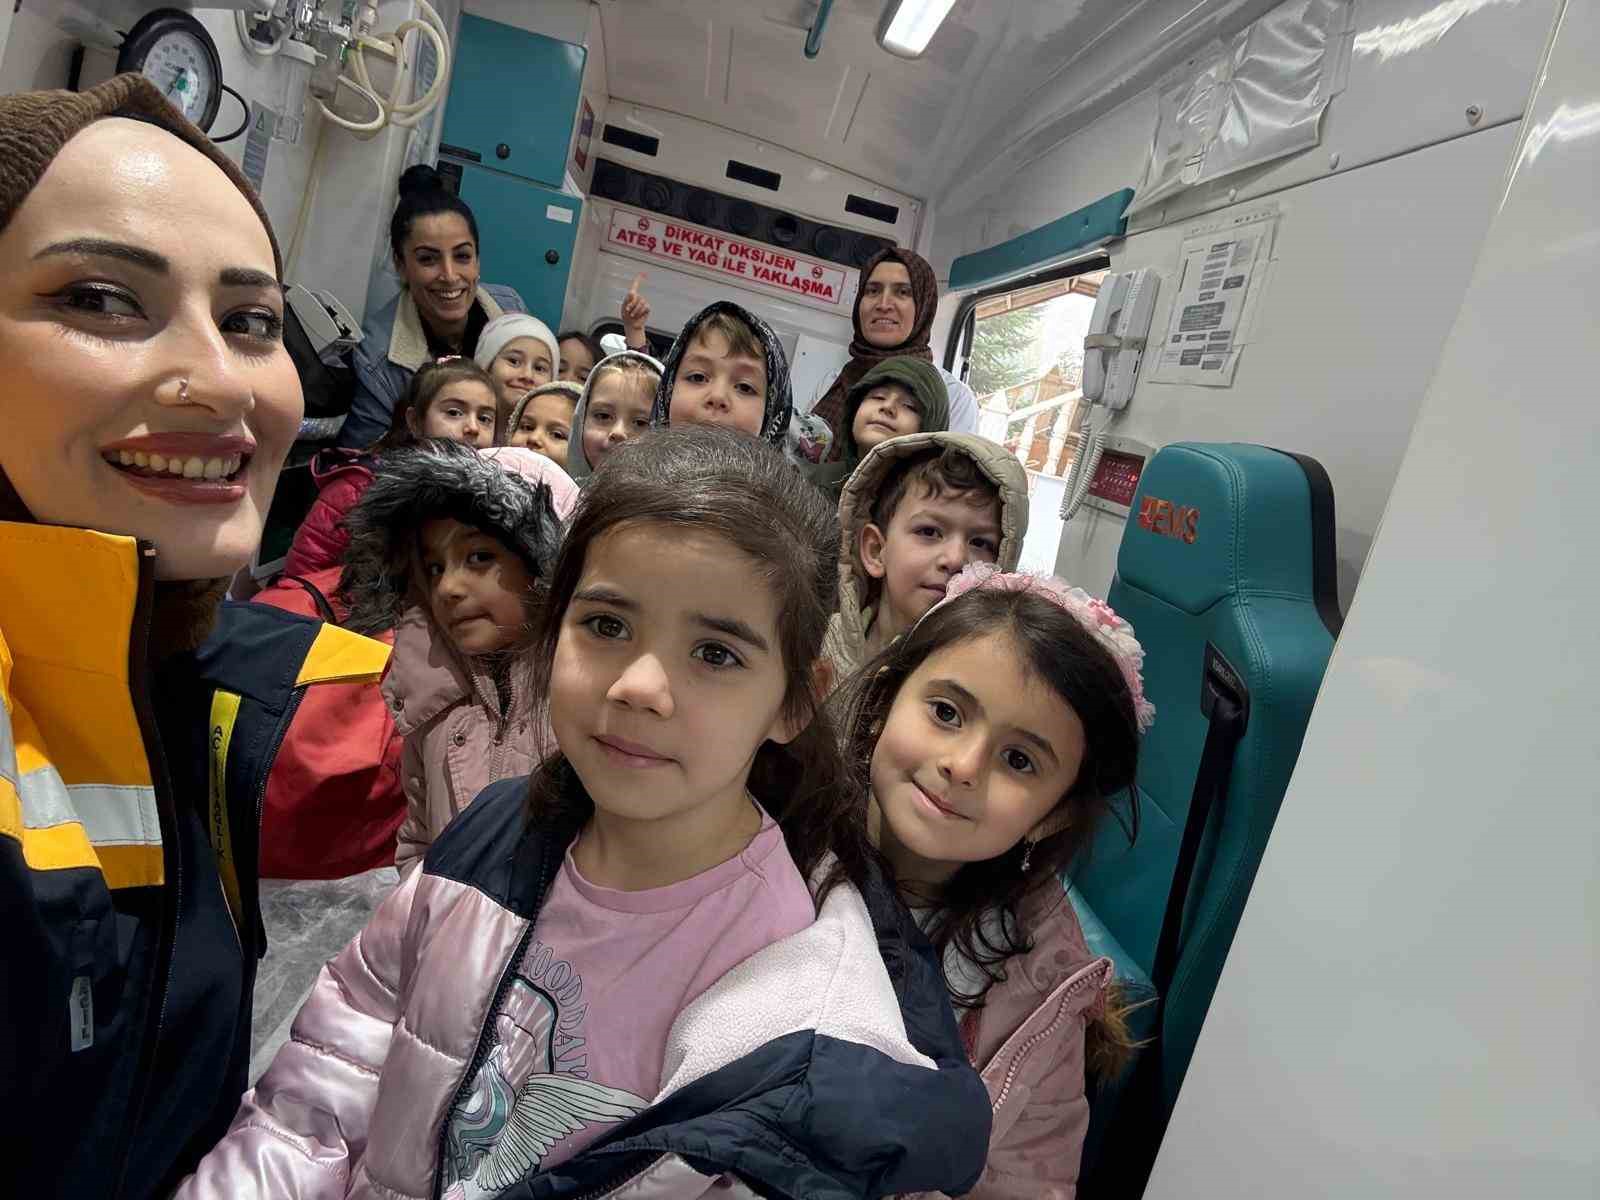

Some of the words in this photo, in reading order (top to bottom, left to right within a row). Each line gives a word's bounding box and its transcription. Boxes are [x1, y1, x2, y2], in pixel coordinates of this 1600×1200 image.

[616, 228, 657, 252] ATEŞ
[662, 240, 682, 256] VE
[687, 246, 718, 266] YAĞ
[722, 256, 747, 274] İLE
[752, 263, 833, 298] YAKLAŞMA
[664, 224, 725, 250] DİKKAT
[728, 243, 797, 271] OKSİJEN
[1151, 498, 1200, 545] EMS
